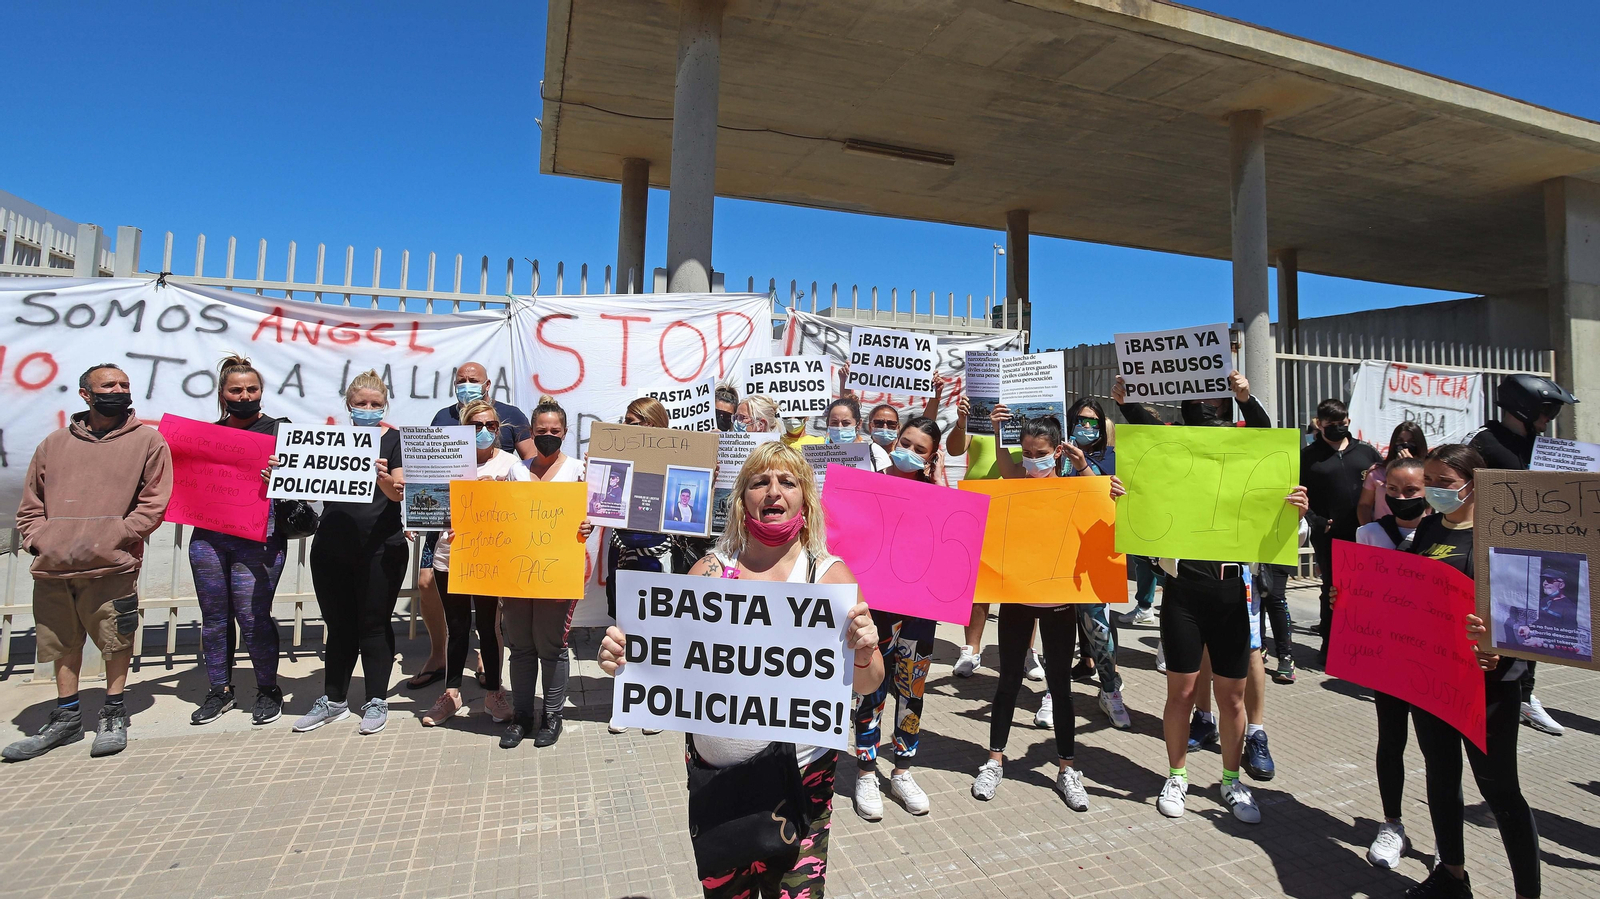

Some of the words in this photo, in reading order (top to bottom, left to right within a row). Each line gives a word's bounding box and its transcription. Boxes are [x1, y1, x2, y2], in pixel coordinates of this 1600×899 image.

[16, 292, 229, 333] SOMOS
[858, 333, 910, 350] ¡BASTA
[914, 338, 931, 352] YA
[1124, 335, 1189, 355] ¡BASTA
[1193, 331, 1220, 347] YA
[532, 311, 754, 395] STOP
[851, 352, 870, 366] DE
[874, 355, 932, 372] ABUSOS
[750, 361, 800, 377] ¡BASTA
[804, 360, 824, 372] YA
[1122, 361, 1145, 375] DE
[1151, 354, 1224, 374] ABUSOS
[695, 383, 710, 397] YA
[746, 382, 764, 394] DE
[769, 379, 825, 394] ABUSOS
[286, 430, 346, 446] ¡BASTA
[353, 432, 372, 448] YA
[598, 428, 690, 452] JUSTICIA
[277, 453, 299, 468] DE
[303, 455, 371, 472] ABUSOS
[272, 477, 373, 496] POLICIALES!
[1127, 442, 1293, 543] CIA
[526, 531, 551, 549] NO
[638, 586, 772, 626] ¡BASTA
[786, 596, 836, 629] YA
[625, 634, 671, 667] DE
[684, 640, 835, 680] ABUSOS
[622, 683, 844, 735] POLICIALES!
